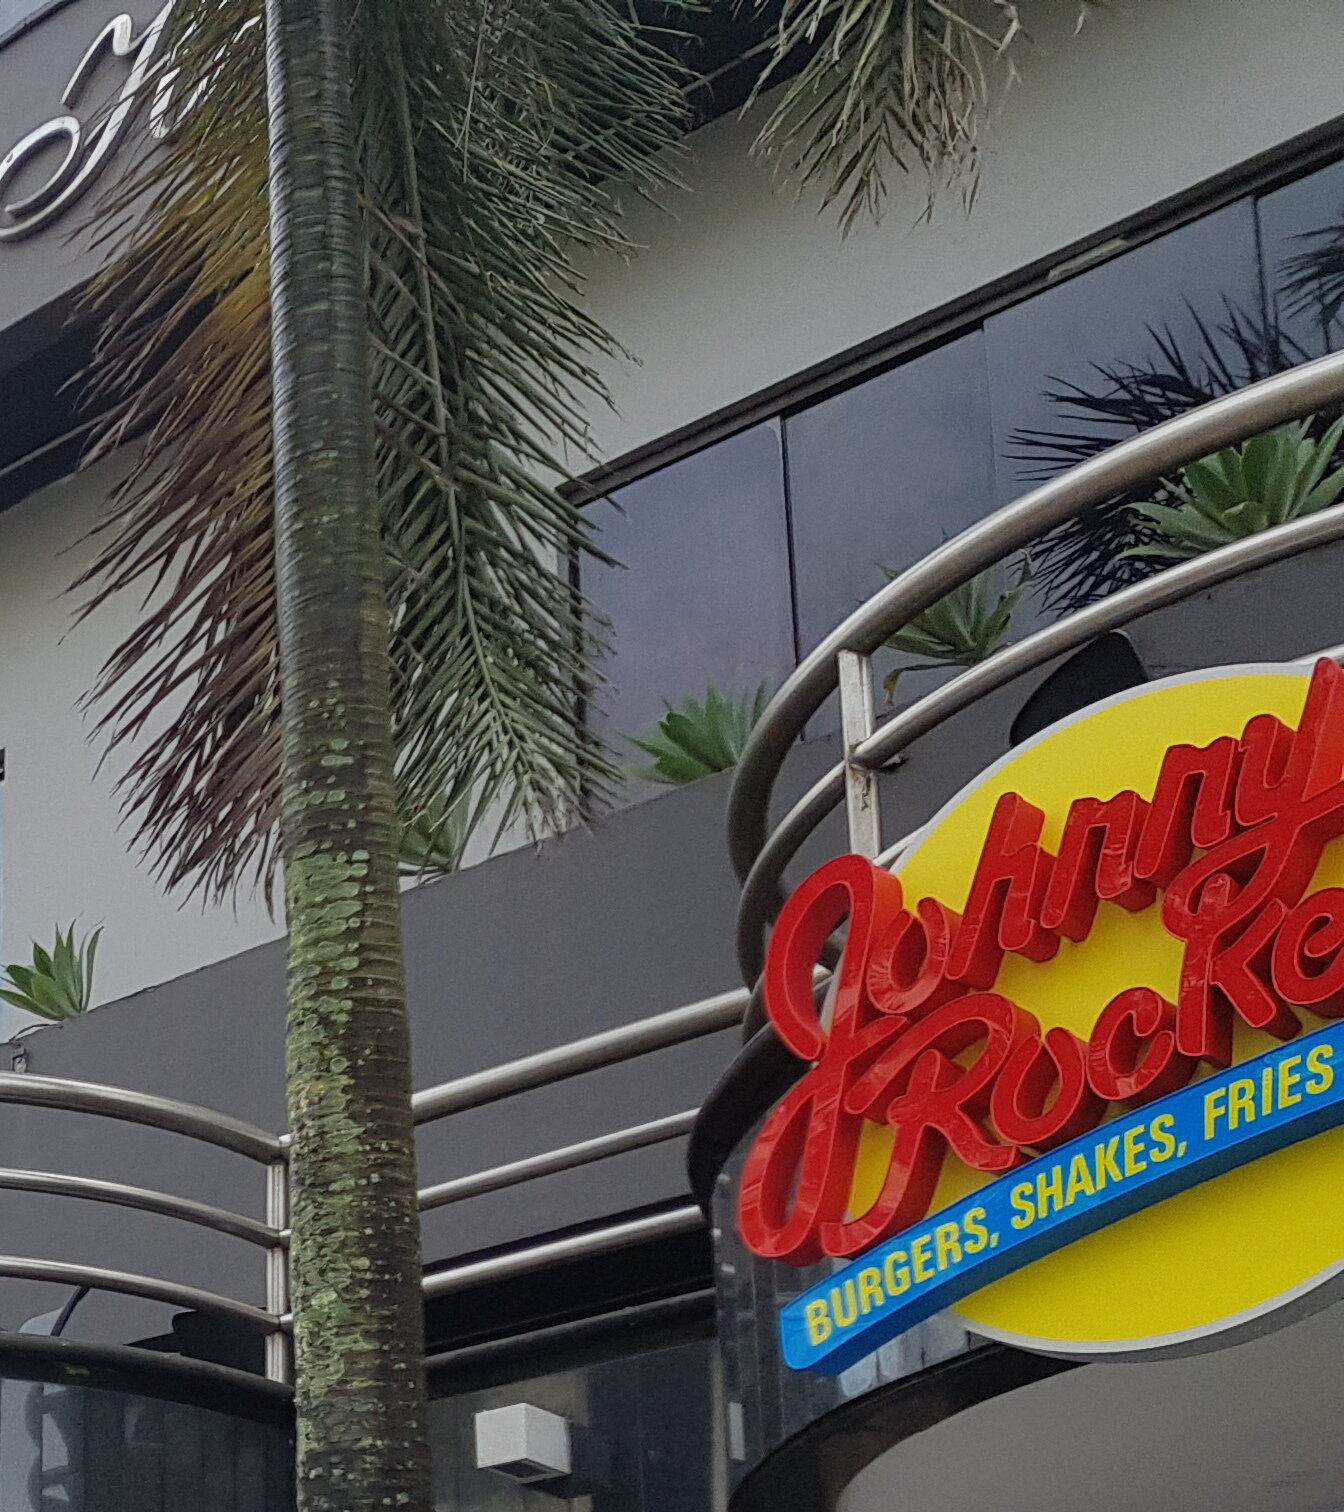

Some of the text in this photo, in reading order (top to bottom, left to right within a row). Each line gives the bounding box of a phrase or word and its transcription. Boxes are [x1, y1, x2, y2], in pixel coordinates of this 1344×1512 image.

[737, 657, 1344, 1266] Johnny
[803, 1042, 1334, 1347] BURGERS, SHAKES, FRIES
